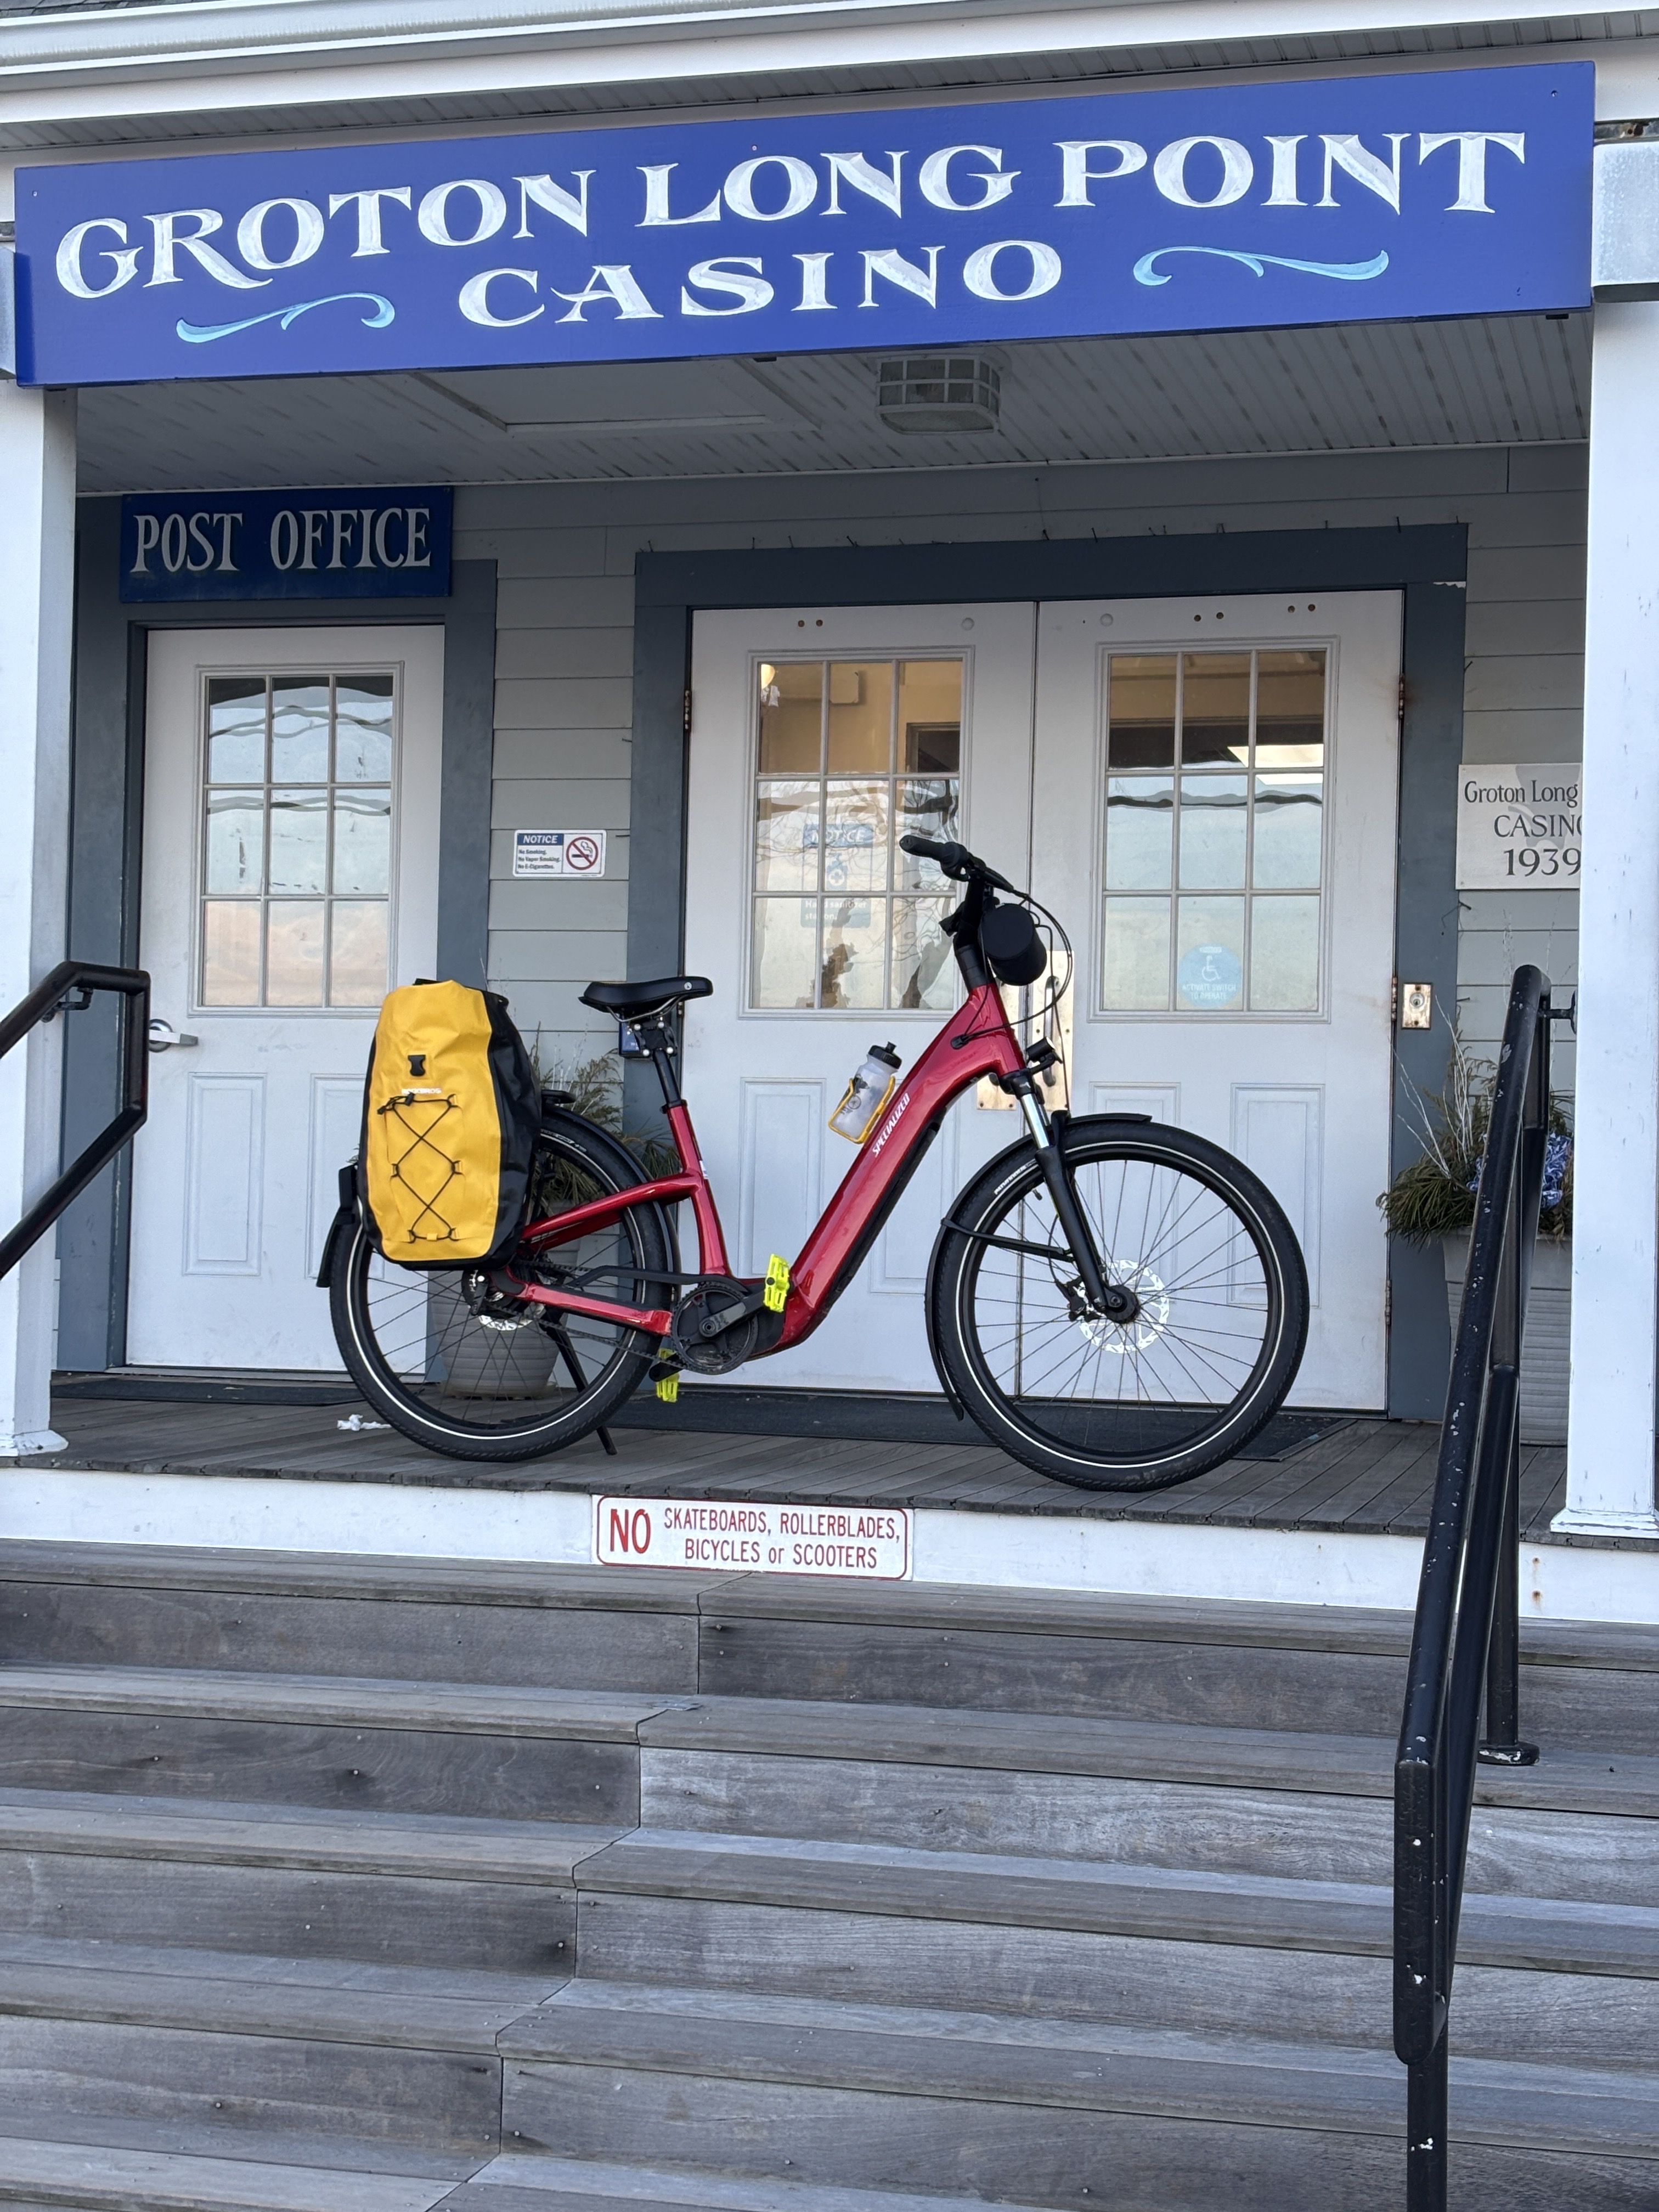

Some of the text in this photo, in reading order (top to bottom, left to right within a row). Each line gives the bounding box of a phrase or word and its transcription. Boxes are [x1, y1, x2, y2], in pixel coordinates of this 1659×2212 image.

[56, 131, 1525, 299] GROTON LONG POINT
[459, 240, 1062, 328] CASINO
[130, 508, 431, 572] POST OFFICE
[1464, 780, 1578, 808] Groton Long
[523, 835, 558, 844] NOTICE
[1494, 814, 1582, 838] CASIN
[1504, 848, 1581, 877] 1939
[872, 1092, 910, 1158] SPECIALIZED
[610, 1509, 651, 1554] NO
[664, 1508, 900, 1543] SKATEBOARDS, ROLLERBLADES,
[685, 1538, 877, 1568] BICYCLES or SCOOTERS
